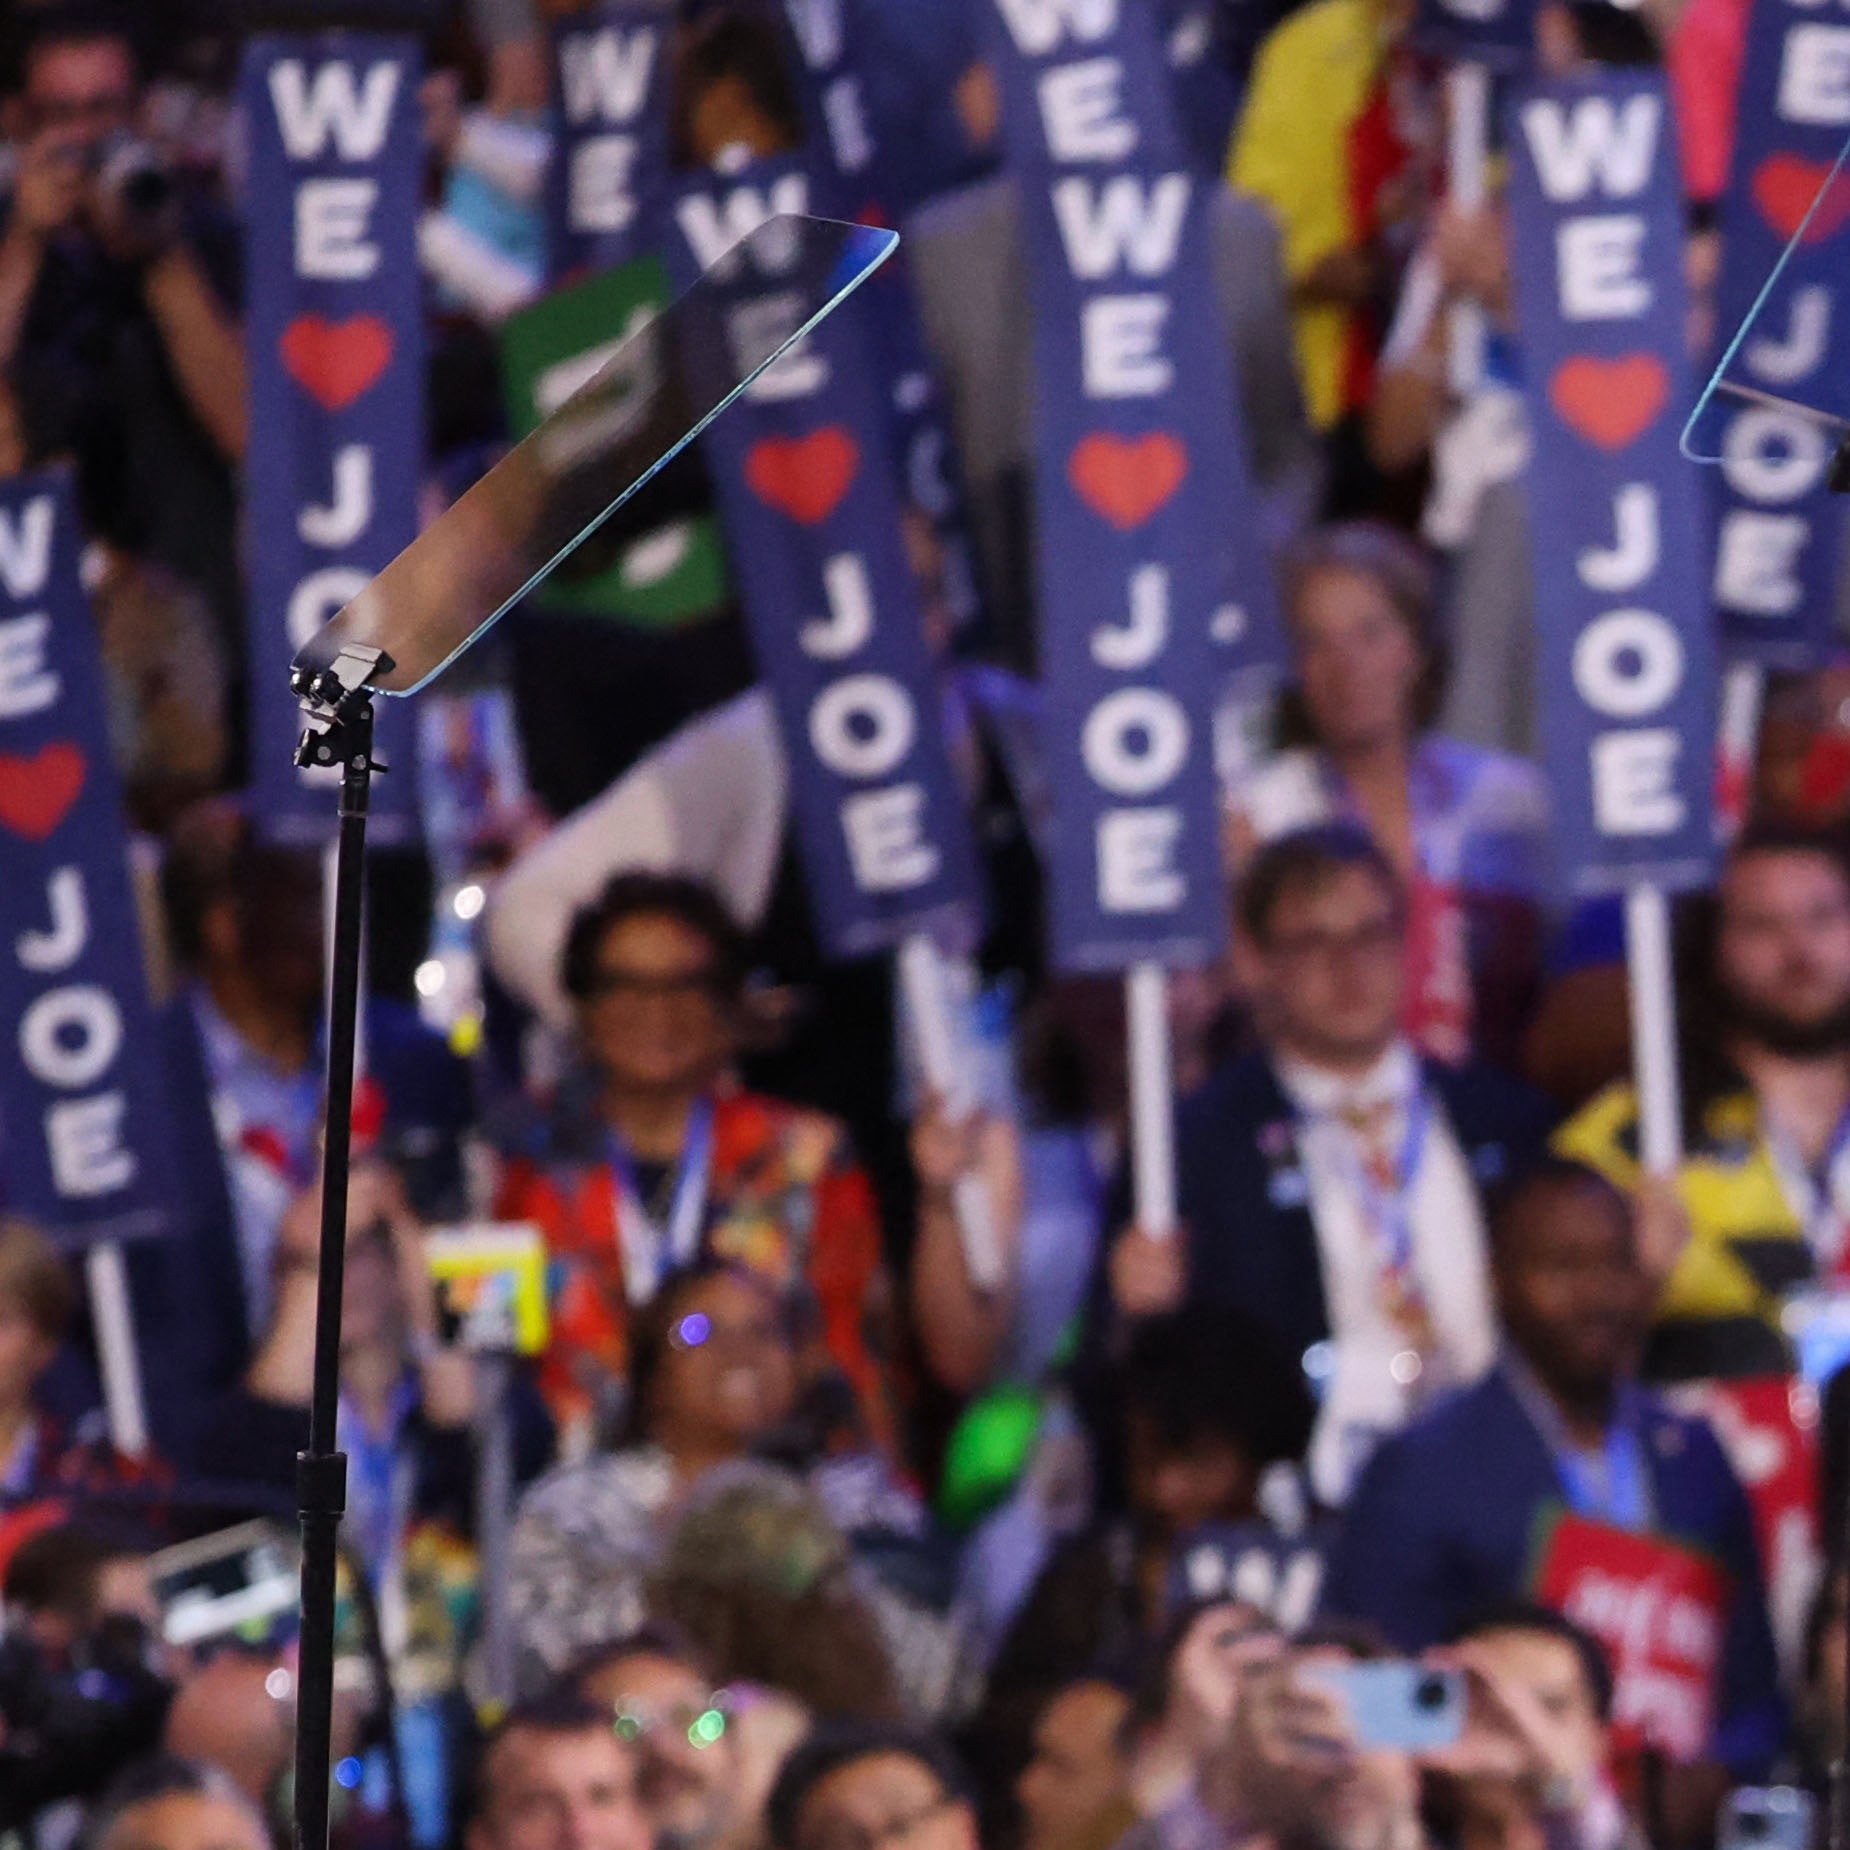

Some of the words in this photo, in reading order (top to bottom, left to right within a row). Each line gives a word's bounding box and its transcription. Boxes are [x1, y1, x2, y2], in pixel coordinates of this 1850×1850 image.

[267, 57, 400, 282] WE
[558, 25, 660, 234] WE
[1048, 171, 1194, 399] WE
[1518, 92, 1662, 323] WE
[674, 171, 832, 403] WE
[798, 550, 942, 894] JOE
[1713, 284, 1832, 617] JOE
[1080, 562, 1194, 914] JOE
[1571, 481, 1688, 838] JOE
[14, 863, 137, 1199] JOE
